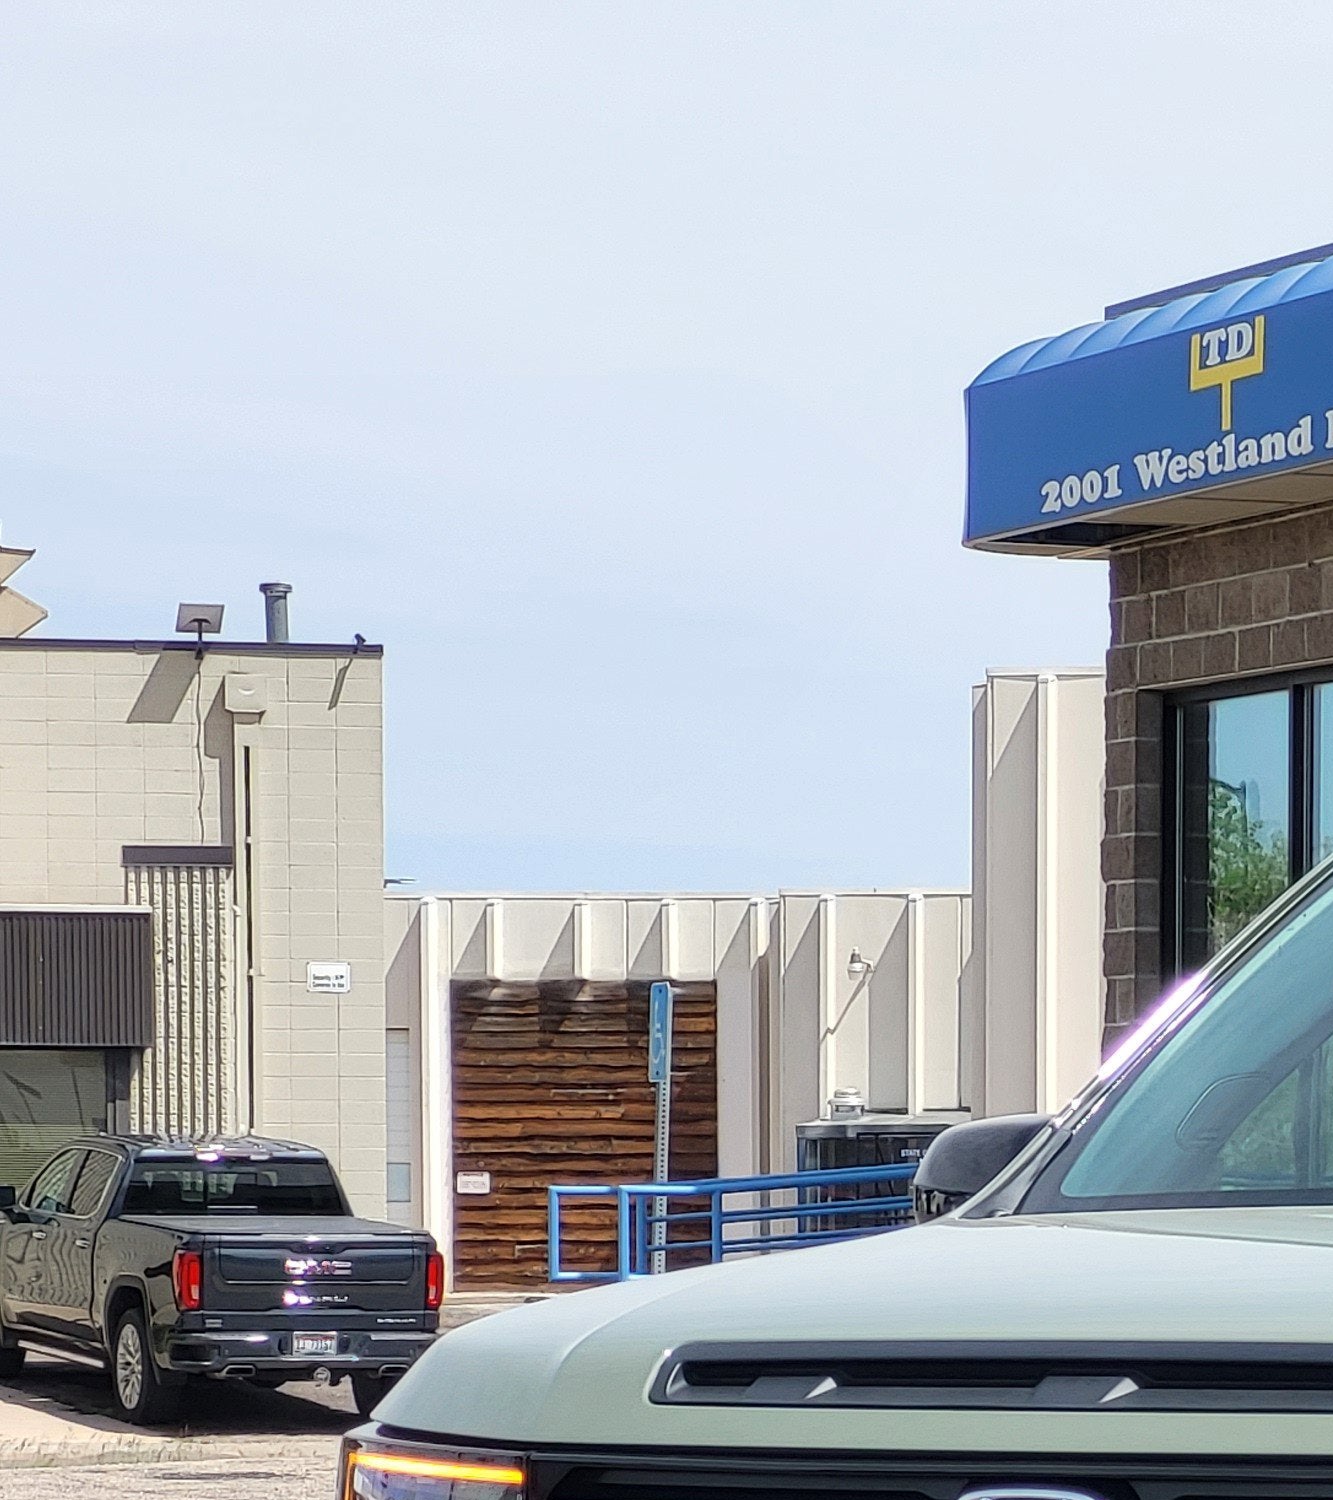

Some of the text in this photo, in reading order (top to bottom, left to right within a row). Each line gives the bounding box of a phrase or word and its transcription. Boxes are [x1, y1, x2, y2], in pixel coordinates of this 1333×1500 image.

[1202, 321, 1254, 366] TD
[1040, 464, 1122, 513] 2001
[1133, 415, 1314, 490] Westland
